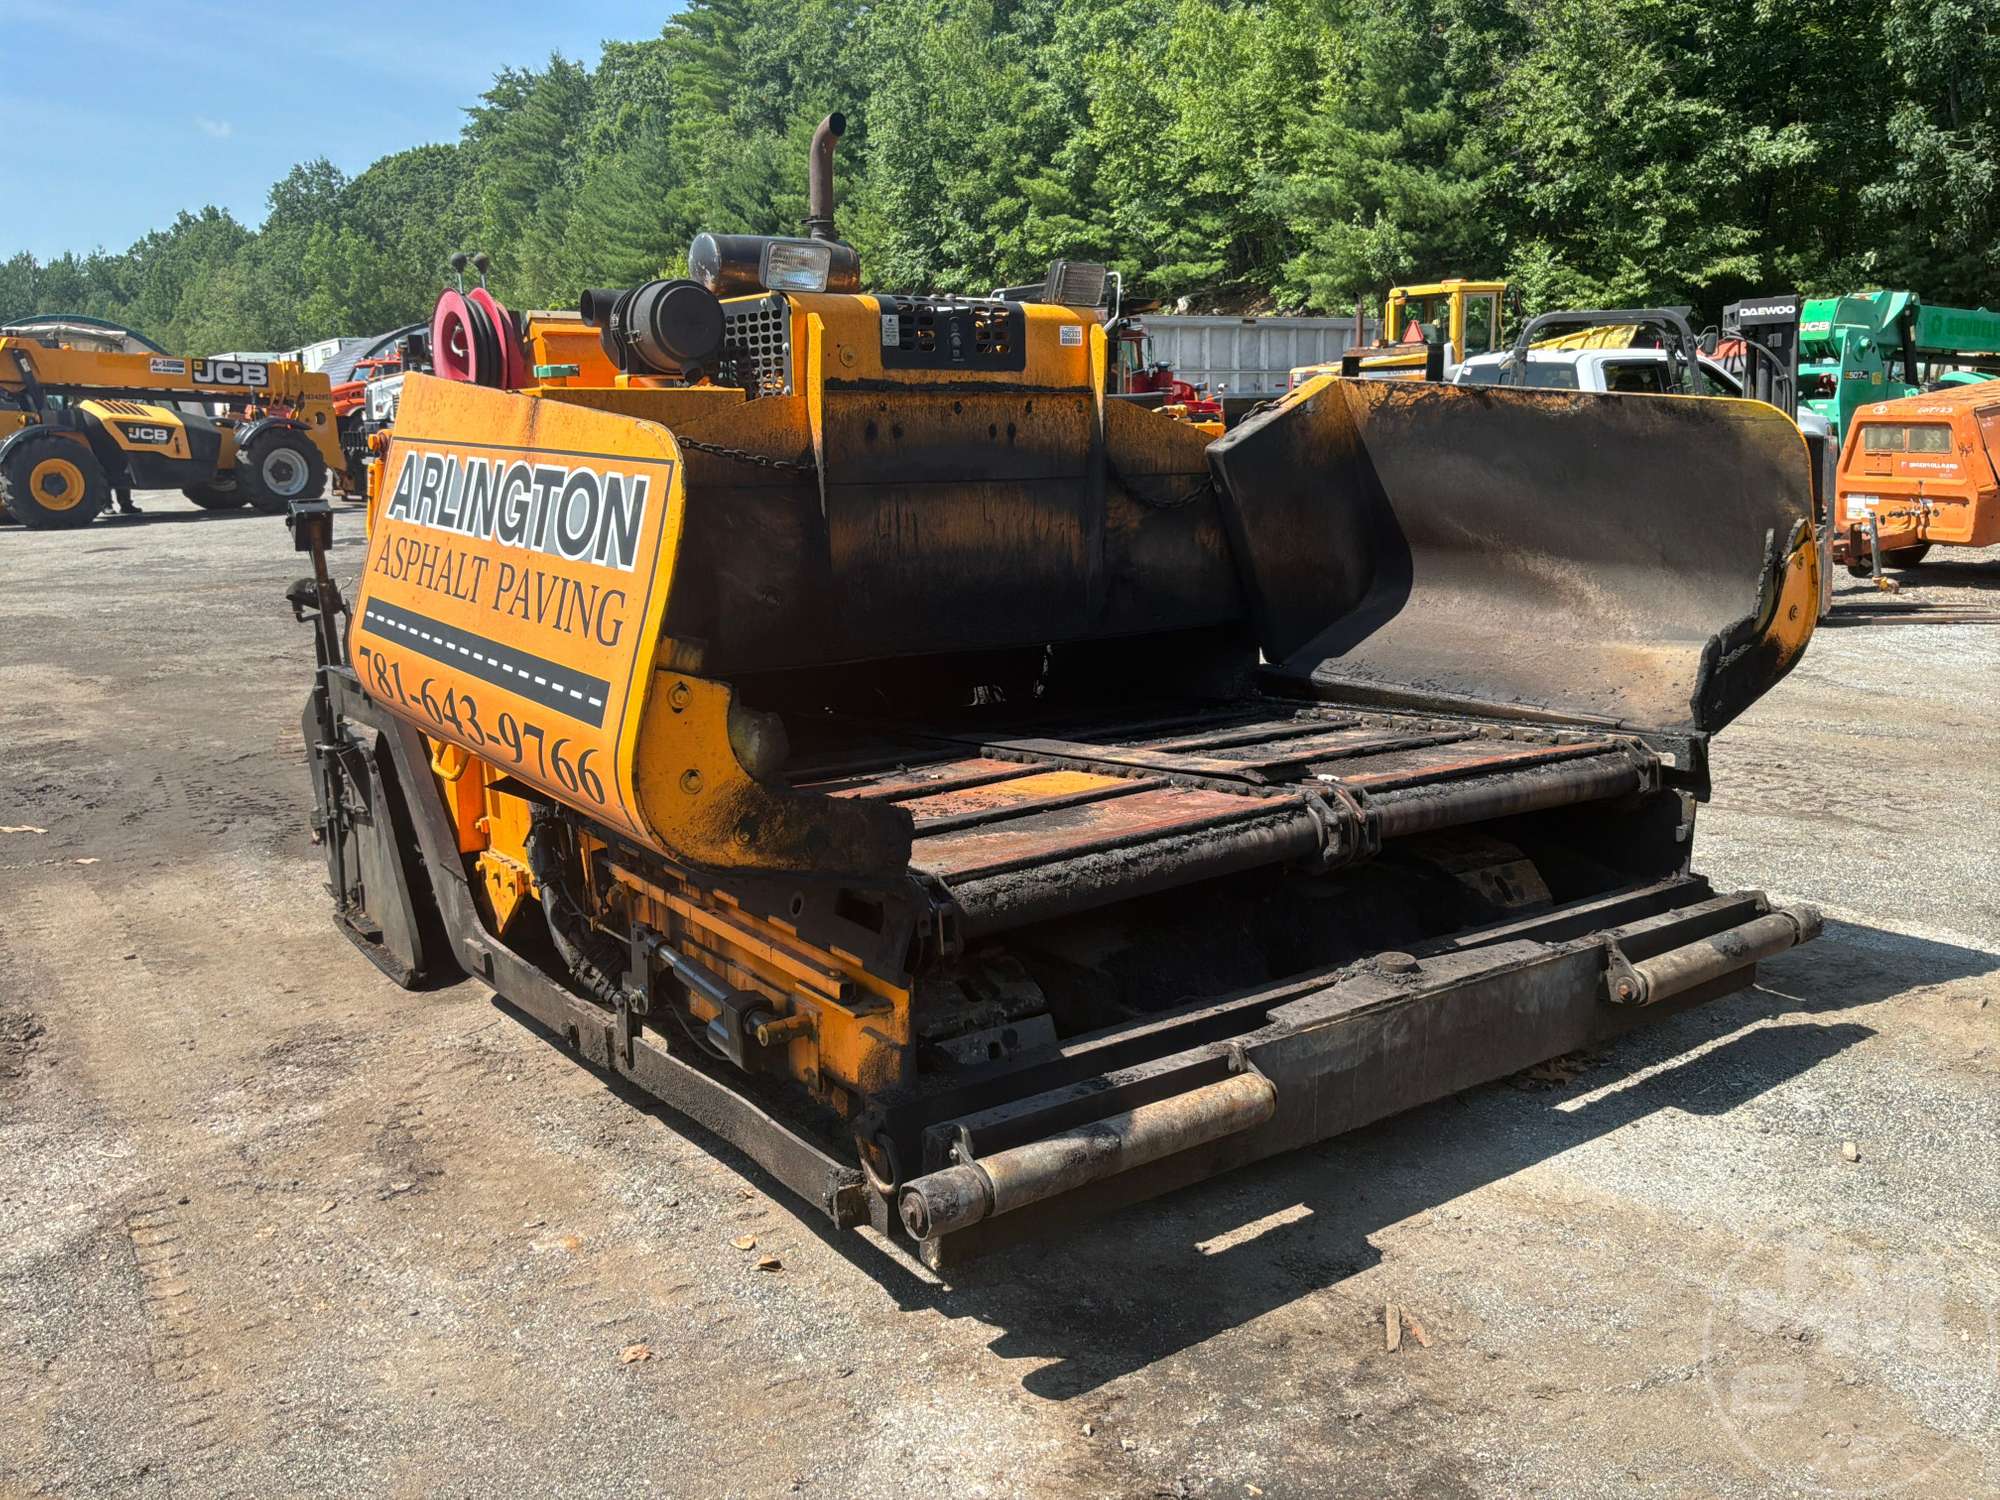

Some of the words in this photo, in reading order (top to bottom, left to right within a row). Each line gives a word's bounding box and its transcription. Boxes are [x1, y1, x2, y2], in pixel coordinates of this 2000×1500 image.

[1739, 305, 1796, 317] DAEWOO
[1800, 321, 1830, 332] JCB
[194, 361, 267, 385] JCB
[128, 427, 168, 440] JCB
[385, 450, 652, 572] ARLINGTON
[373, 533, 490, 604] ASPHALT
[491, 562, 627, 648] PAVING
[359, 645, 607, 805] 781-643-9766
